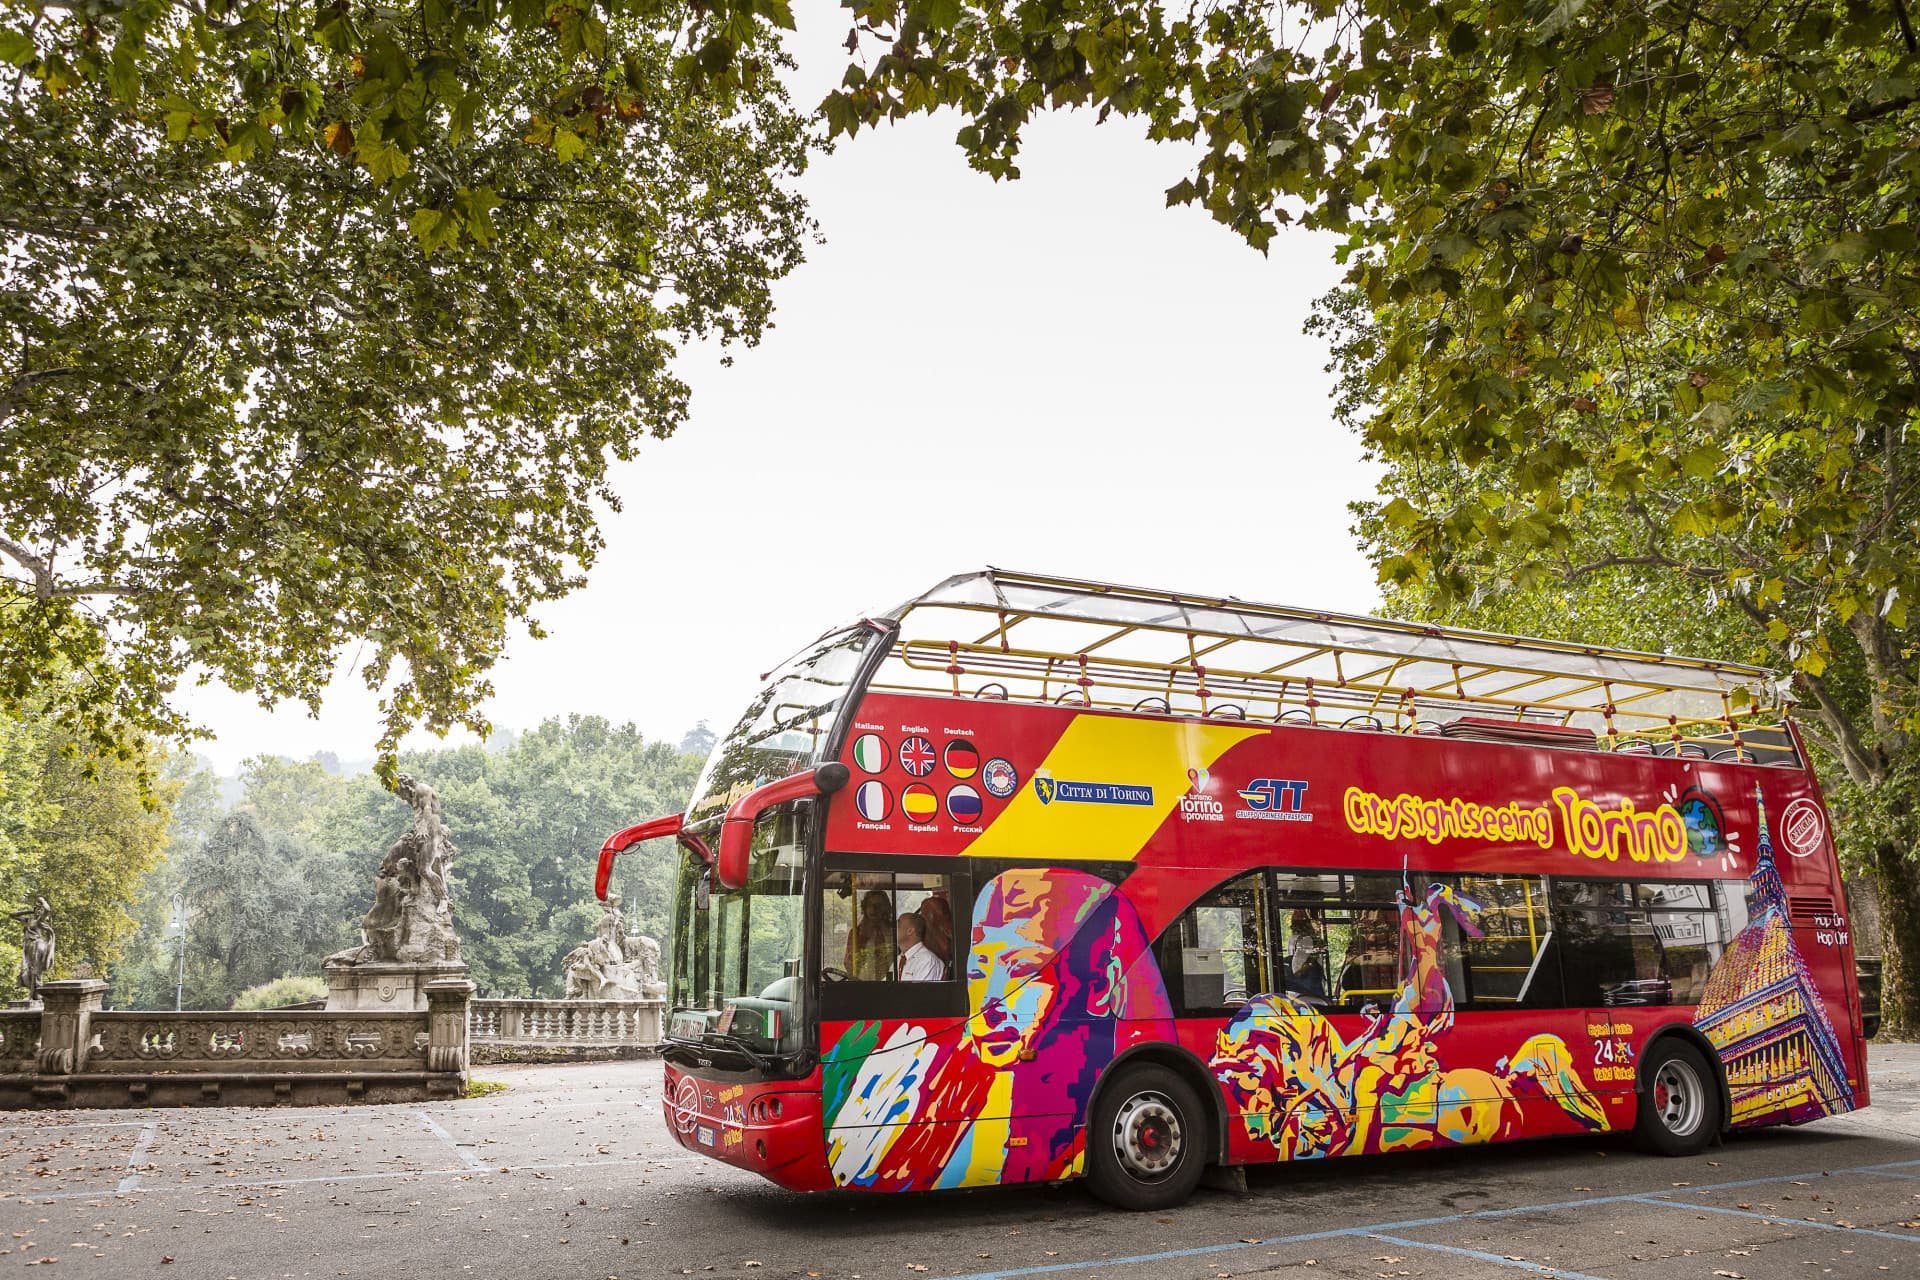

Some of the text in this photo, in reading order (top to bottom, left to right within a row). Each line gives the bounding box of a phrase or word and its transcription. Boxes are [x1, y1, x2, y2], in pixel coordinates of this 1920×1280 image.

[855, 722, 884, 731] Italiano
[901, 725, 929, 734] English
[944, 727, 974, 736] Deutsch
[1096, 788, 1107, 799] DI
[1109, 786, 1150, 801] TORINO
[1189, 793, 1212, 801] turismo
[1237, 778, 1309, 812] GTT
[1176, 795, 1223, 814] Torino
[1186, 812, 1224, 823] provincia
[857, 821, 891, 831] Français
[908, 824, 938, 833] Español
[1552, 786, 1688, 863] Torino
[1790, 811, 1816, 842] OFFICIAL
[1816, 931, 1849, 946] Hop Off
[1594, 1039, 1614, 1065] 24
